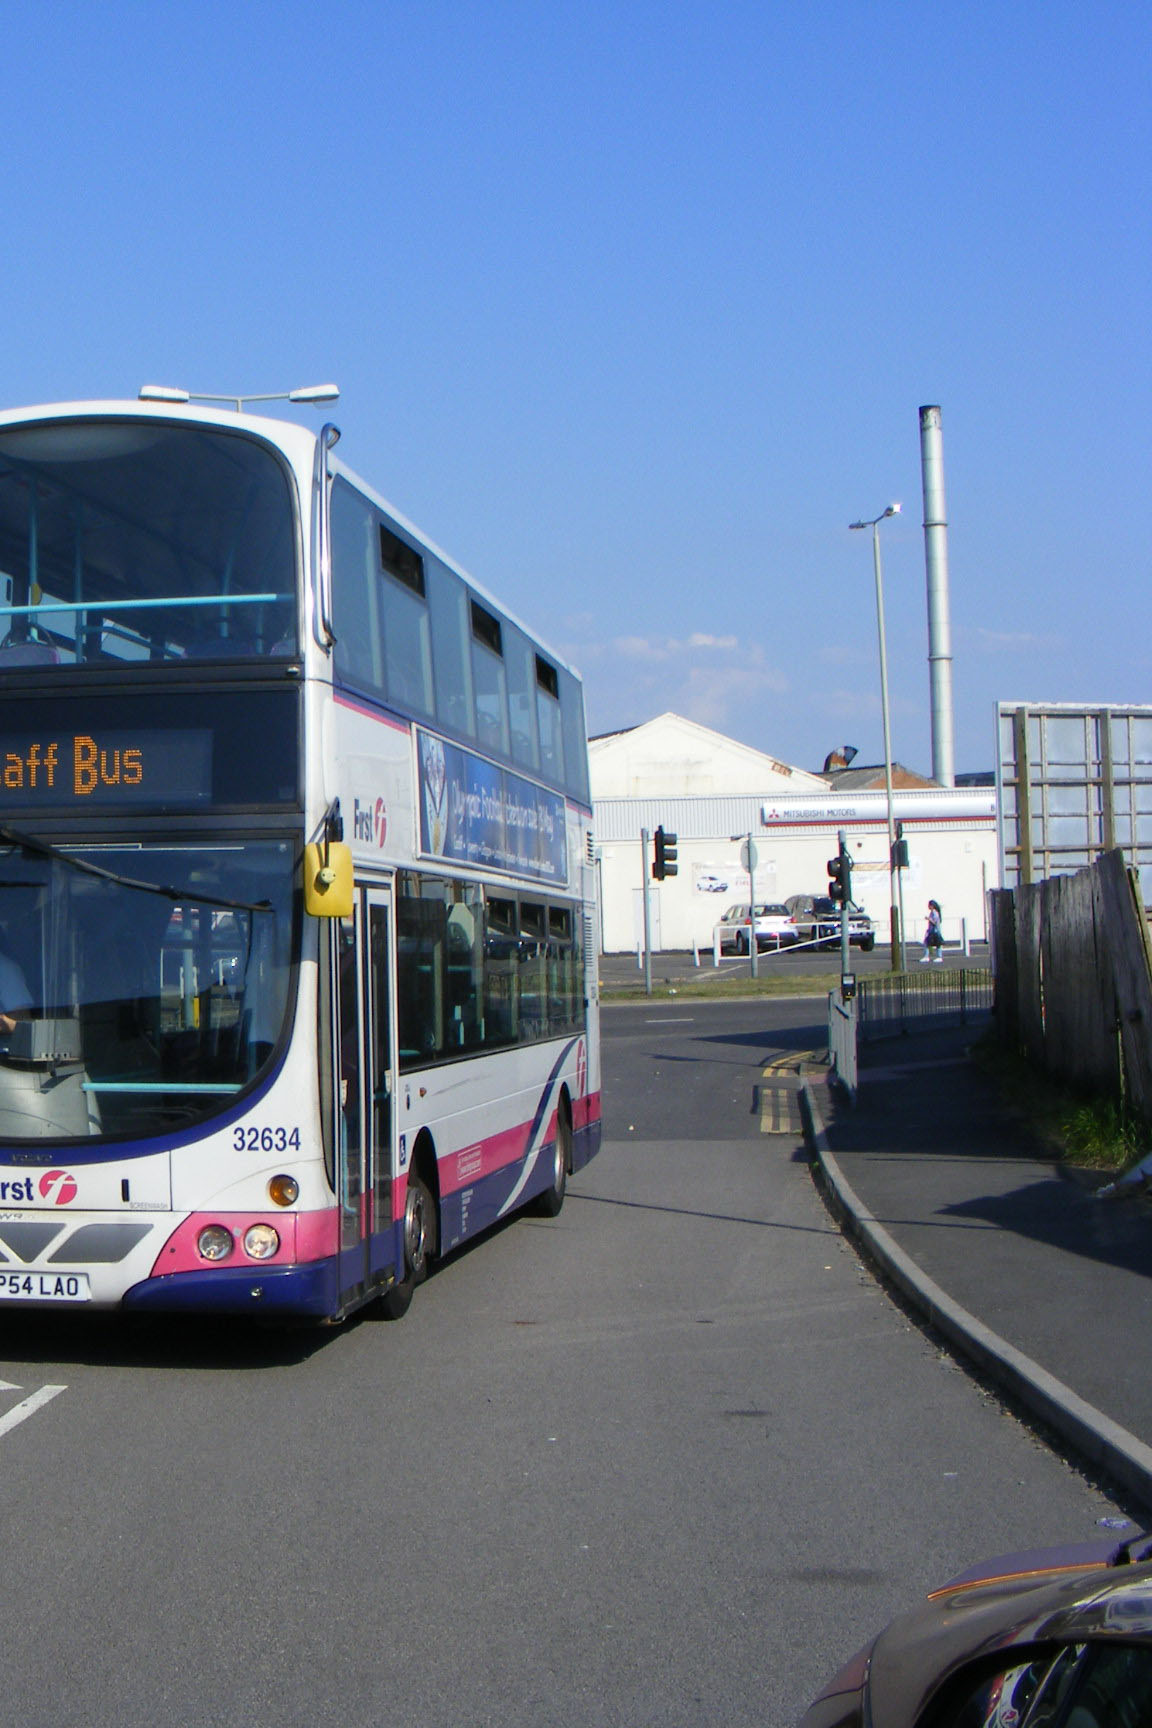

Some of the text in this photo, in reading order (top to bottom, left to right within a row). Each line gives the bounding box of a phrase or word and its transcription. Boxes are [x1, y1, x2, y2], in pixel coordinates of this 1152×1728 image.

[75, 736, 142, 794] Bus
[354, 798, 373, 843] First
[783, 808, 856, 818] MITSUBISHI MOTORS
[233, 1127, 301, 1152] 32634
[39, 1277, 79, 1297] LAO
